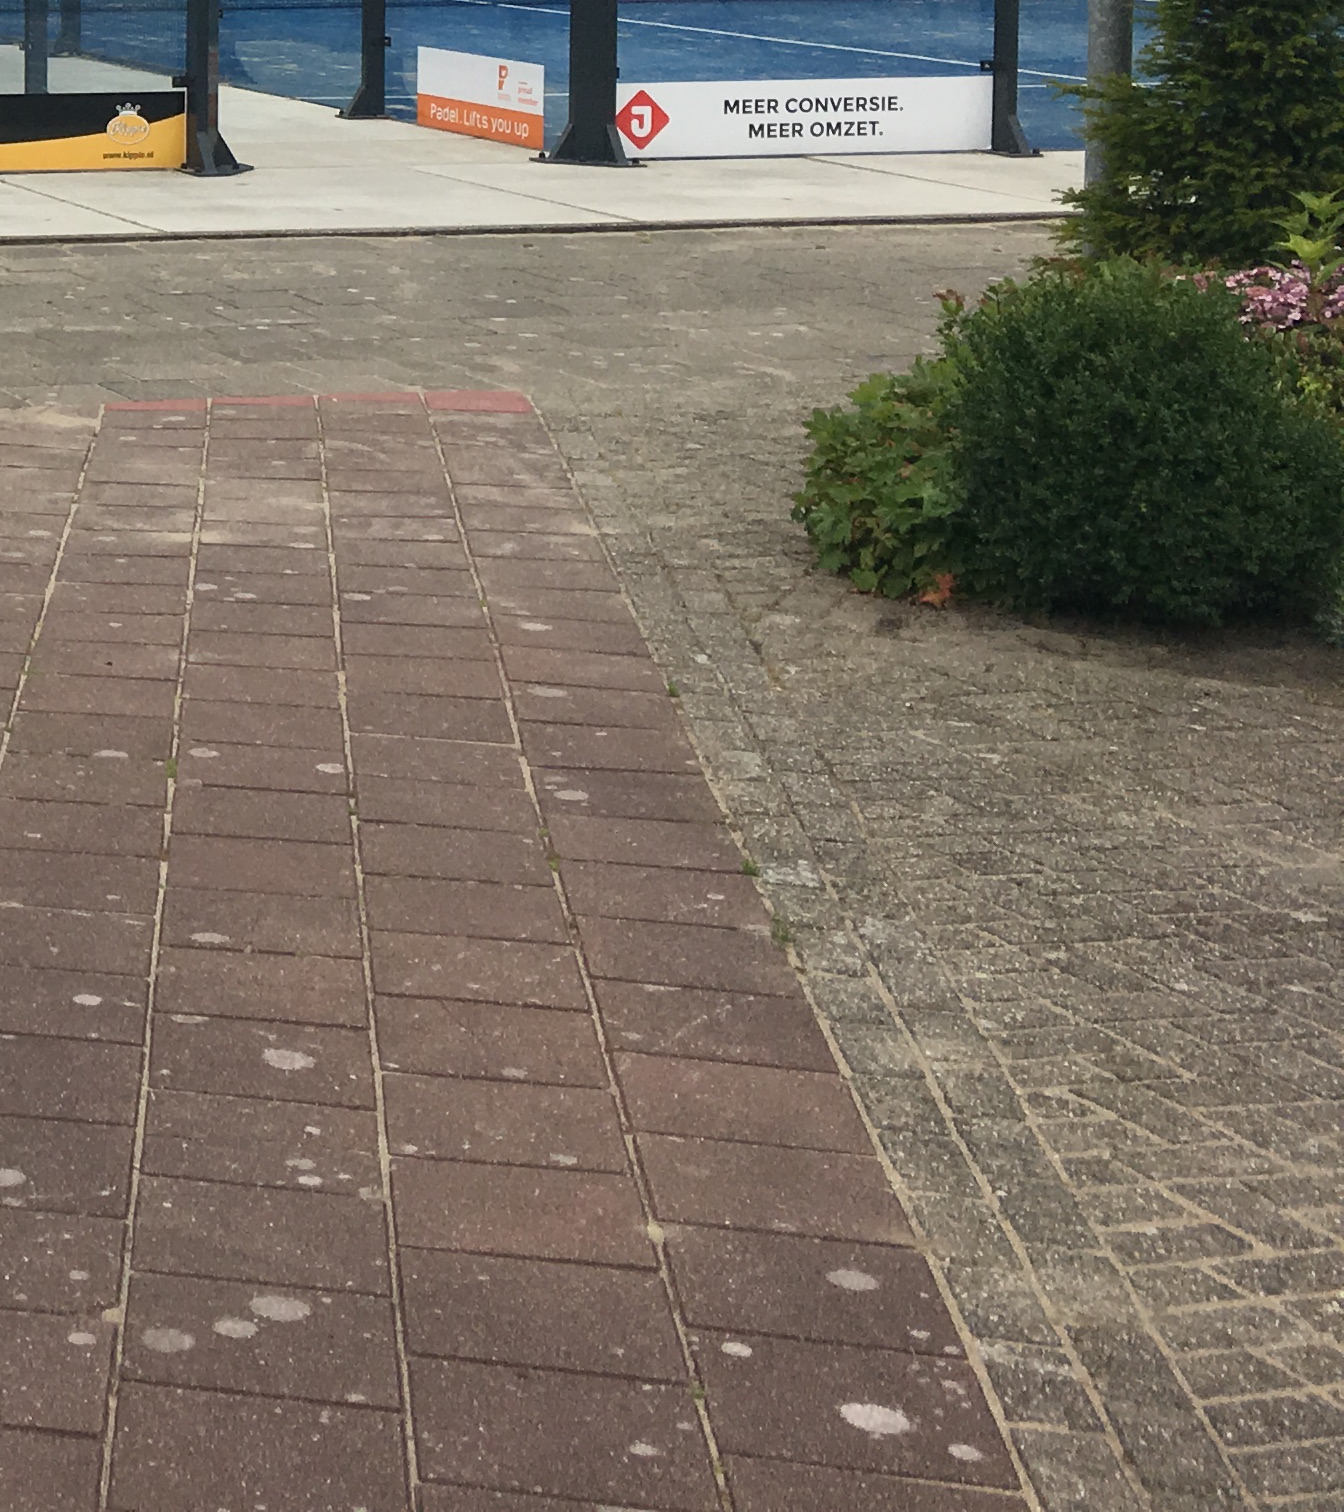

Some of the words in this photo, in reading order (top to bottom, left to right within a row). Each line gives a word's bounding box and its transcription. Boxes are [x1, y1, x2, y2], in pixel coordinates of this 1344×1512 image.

[724, 99, 779, 114] MEER
[785, 96, 904, 113] CONVERSIE.
[464, 110, 488, 129] Lifts
[490, 116, 511, 133] you
[514, 121, 529, 139] up
[630, 105, 652, 139] J
[748, 123, 804, 138] MEER
[810, 121, 884, 137] OMZET.
